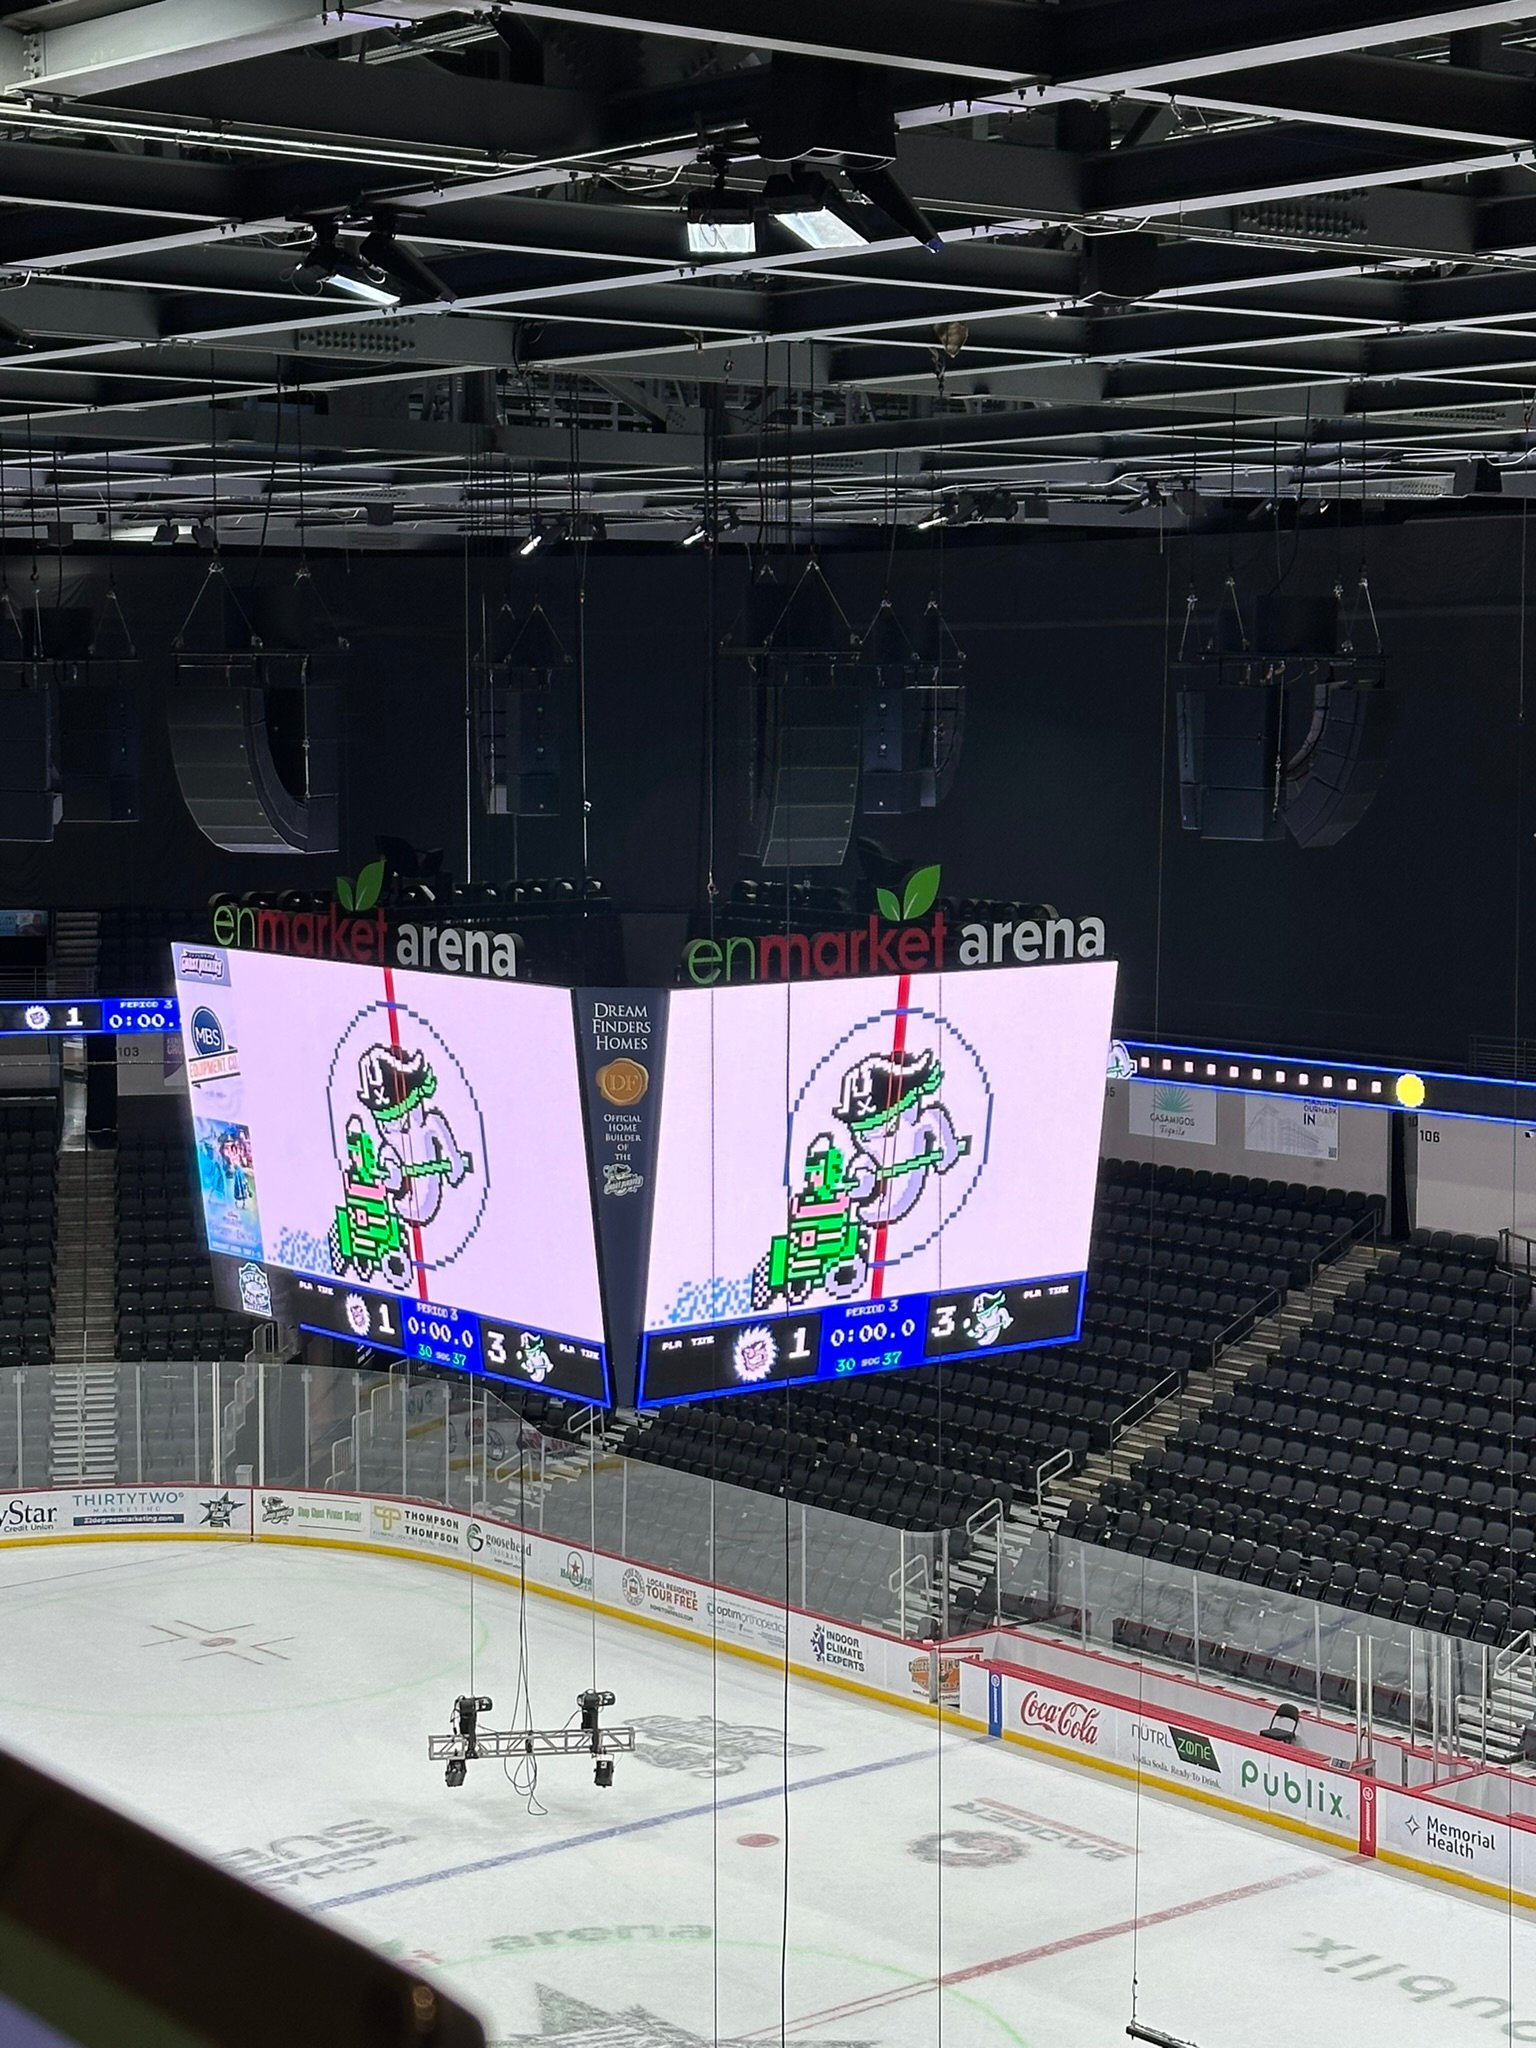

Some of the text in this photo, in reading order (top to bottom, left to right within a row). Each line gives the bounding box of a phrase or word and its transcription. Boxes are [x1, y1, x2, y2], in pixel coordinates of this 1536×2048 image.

[213, 902, 518, 977] enmarket arena
[688, 911, 1105, 984] enmarket arena
[164, 1000, 173, 1009] 3
[594, 1002, 648, 1019] DREAM
[66, 1007, 83, 1026] 1
[109, 1013, 181, 1028] 0:00.
[195, 1026, 220, 1046] MBS
[592, 1019, 651, 1034] FINDERS
[118, 1047, 139, 1057] 103
[595, 1035, 648, 1051] HOMES
[604, 1113, 641, 1123] OFFICIAL
[608, 1123, 637, 1132] HOME
[1150, 1112, 1195, 1126] CASAMIGOS
[605, 1133, 641, 1143] BUILDER
[1420, 1130, 1440, 1143] 106
[617, 1143, 629, 1151] OF
[614, 1153, 631, 1161] THE
[417, 1302, 459, 1321] PERIOD 3
[845, 1299, 899, 1318] PERIOD 3
[379, 1303, 395, 1335] 1
[931, 1305, 957, 1337] 3
[408, 1316, 474, 1348] 0:00.0
[830, 1318, 916, 1347] 0:00.0
[487, 1331, 507, 1364] 3
[788, 1327, 811, 1359] 1
[418, 1343, 433, 1358] 30
[452, 1352, 467, 1366] 37
[835, 1358, 856, 1372] 30
[881, 1351, 902, 1366] 37
[4, 1525, 28, 1533] Credit
[404, 1510, 459, 1530] THOMPSON
[404, 1525, 459, 1545] THOMPSON
[486, 1533, 532, 1557] goosehed
[647, 1577, 697, 1598] LOCAL RESIDENTS
[645, 1585, 673, 1604] TOUR
[674, 1593, 699, 1611] FREE
[826, 1630, 860, 1648] INDOOR
[826, 1642, 863, 1660] CLIMATE
[826, 1653, 865, 1672] EXPERTS
[1177, 1737, 1212, 1761] ZONE
[1427, 1815, 1496, 1850] Memorial
[1427, 1831, 1474, 1860] Health
[486, 1923, 713, 1951] arena
